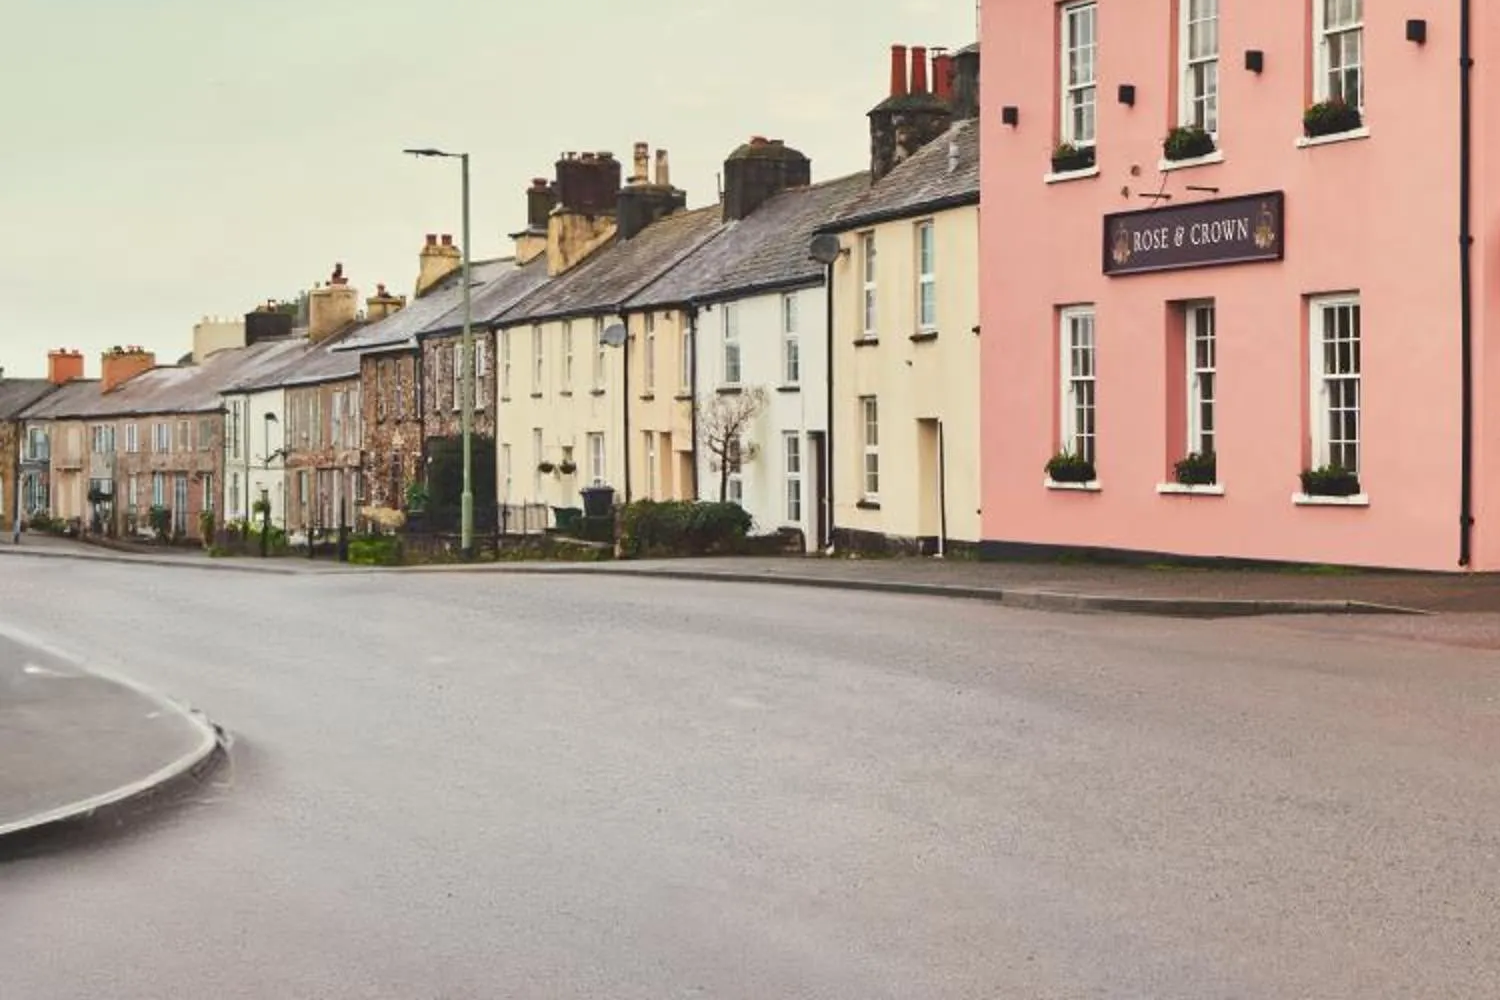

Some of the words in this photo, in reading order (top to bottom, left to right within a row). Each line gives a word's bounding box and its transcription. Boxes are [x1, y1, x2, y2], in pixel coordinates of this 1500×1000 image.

[1133, 227, 1168, 251] ROSE
[1174, 226, 1184, 247] &
[1190, 218, 1249, 245] CROWN
